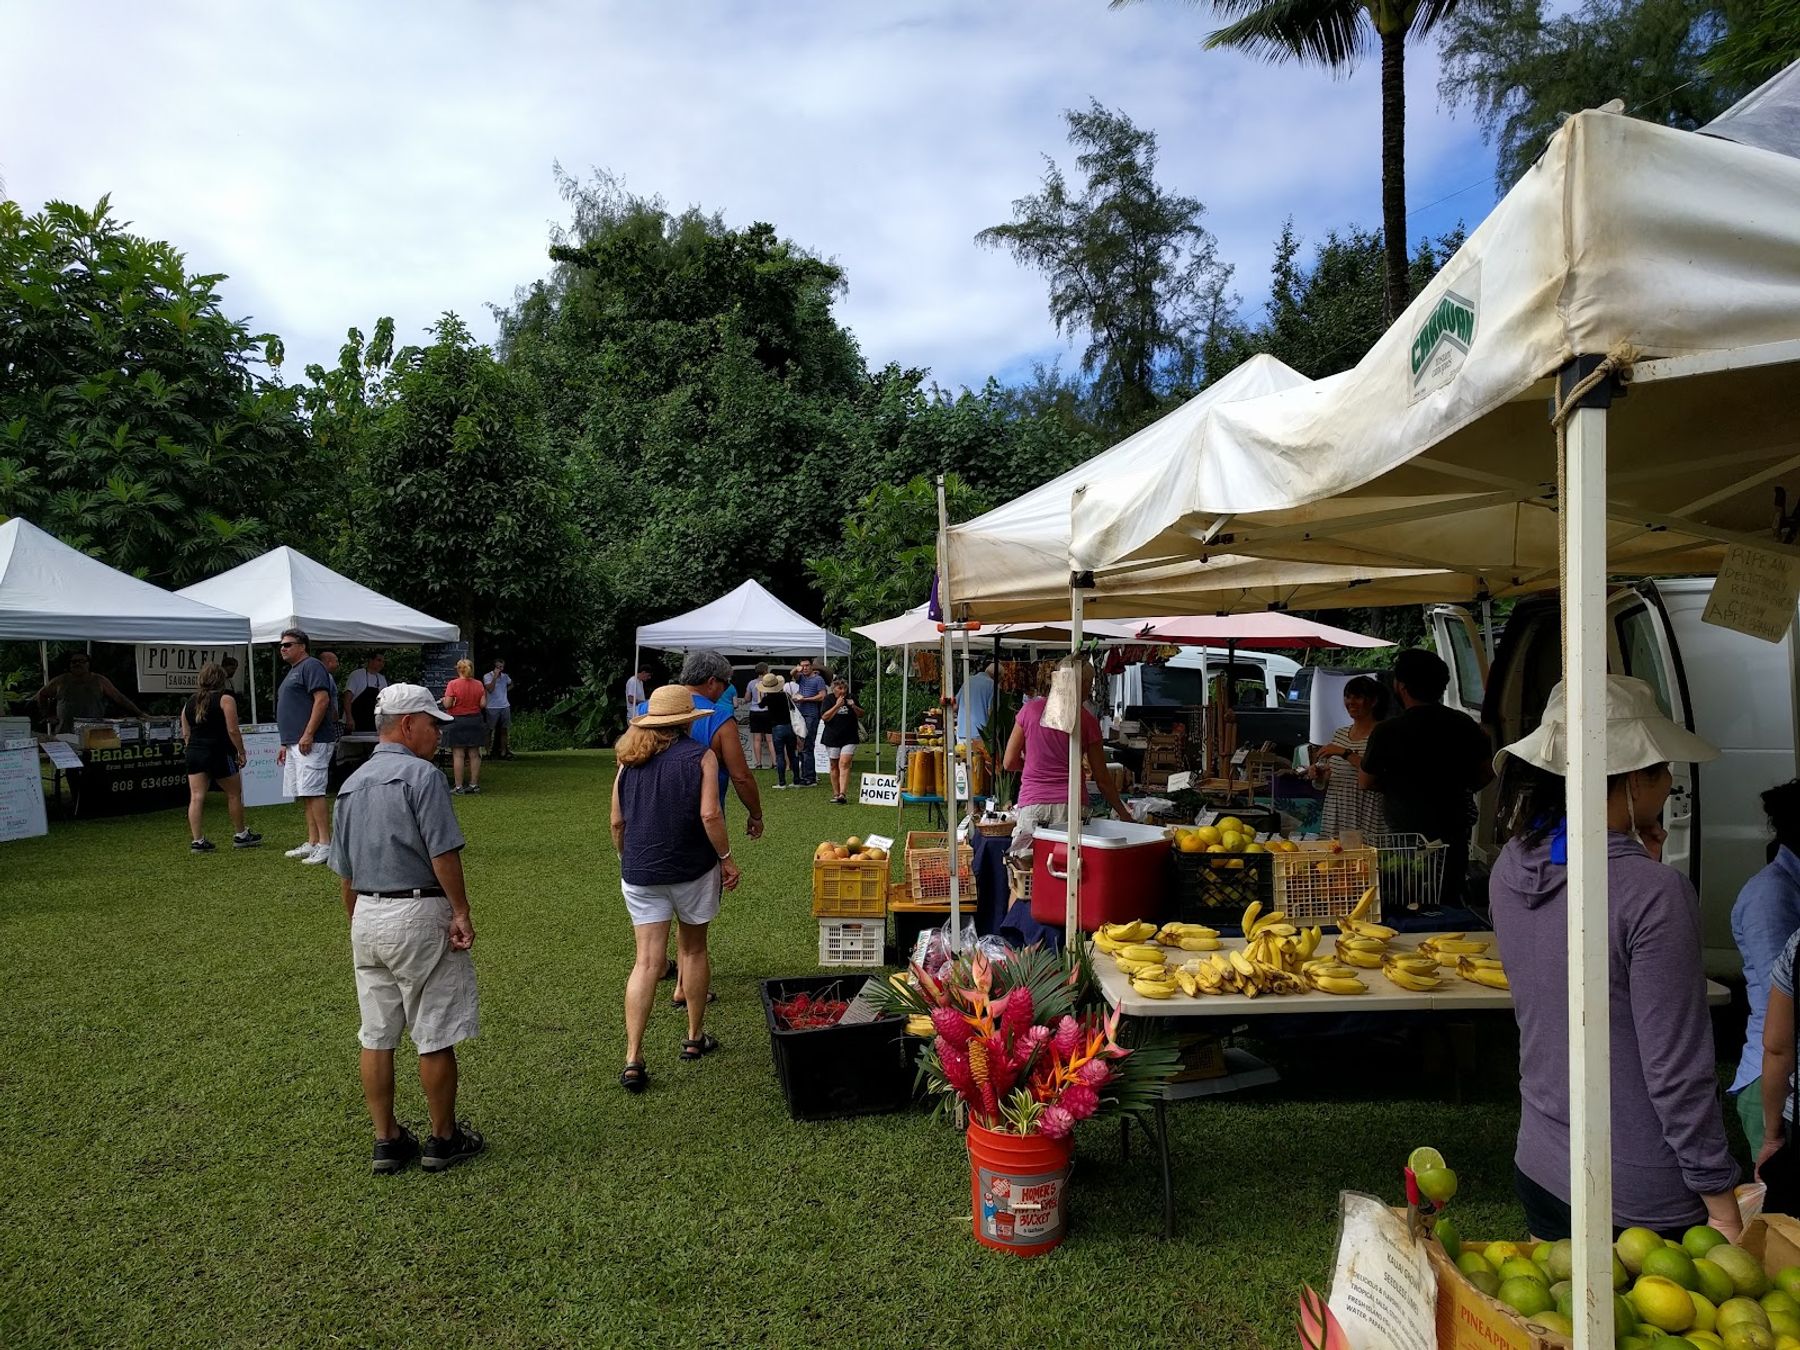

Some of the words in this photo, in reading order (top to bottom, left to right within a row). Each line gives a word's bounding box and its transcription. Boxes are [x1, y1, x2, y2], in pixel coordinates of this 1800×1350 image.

[1411, 297, 1475, 375] CARAVAN
[168, 674, 198, 686] SAUSAG
[90, 743, 163, 762] Hanalei
[112, 779, 134, 792] 808
[141, 774, 187, 789] 6346996
[860, 788, 898, 800] HONEY
[1020, 1211, 1051, 1227] BUCKET
[1350, 1282, 1375, 1302] TROPICAL
[1383, 1271, 1408, 1301] SEEDLESS
[1347, 1294, 1366, 1310] FRESH
[1460, 1305, 1518, 1350] PINEAPPL
